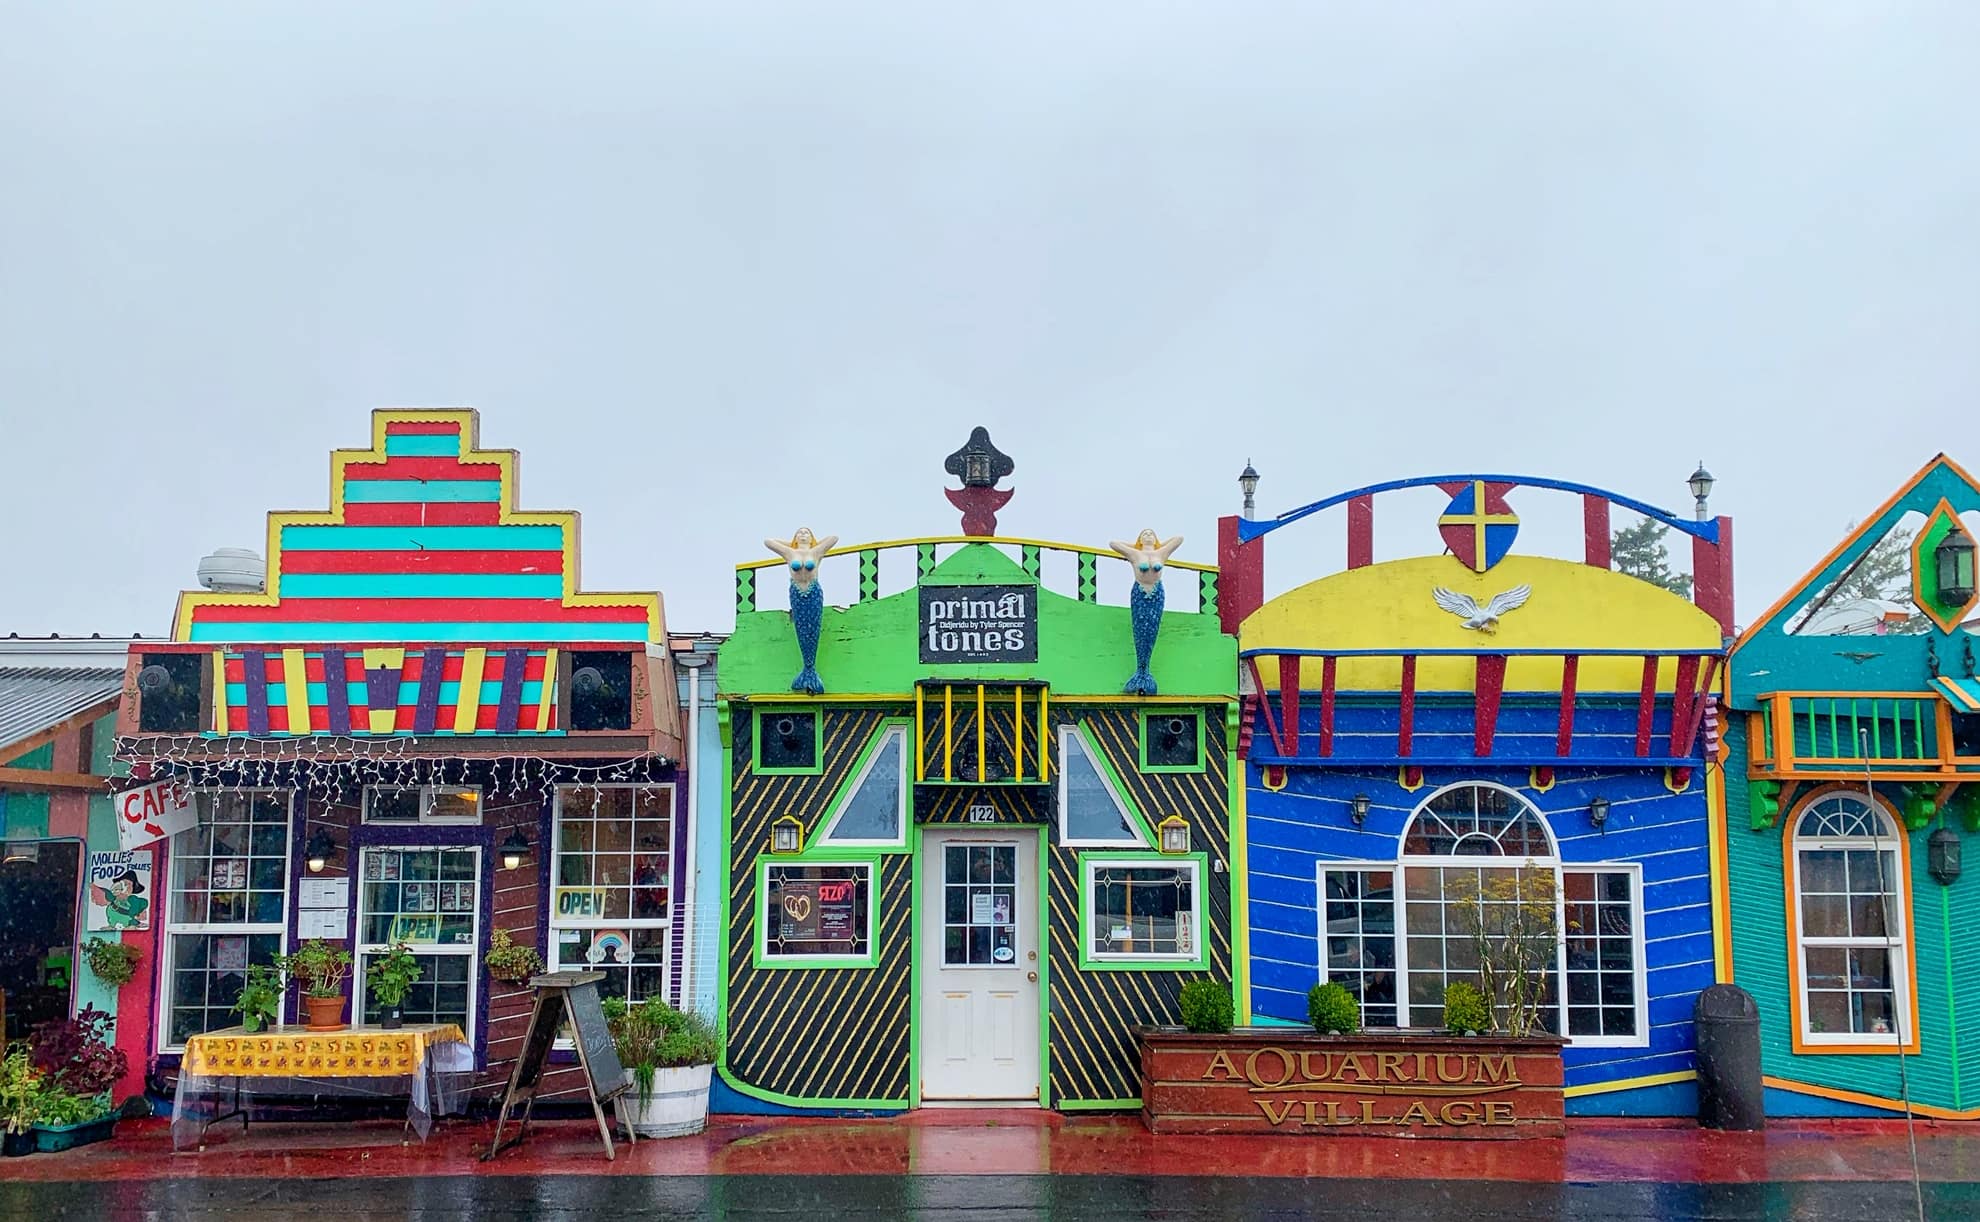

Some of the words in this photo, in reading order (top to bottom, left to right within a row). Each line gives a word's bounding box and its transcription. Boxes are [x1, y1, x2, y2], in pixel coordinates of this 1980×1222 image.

[929, 592, 1026, 625] primal
[970, 621, 979, 629] by
[980, 621, 998, 629] Tyler
[998, 621, 1025, 629] Spencer
[928, 625, 1025, 652] tones
[124, 778, 188, 824] CAFE
[971, 807, 993, 821] 122
[91, 865, 125, 882] FOOD
[127, 863, 152, 873] FOLLIES
[559, 891, 604, 915] OPEN
[1202, 1047, 1522, 1093] AQUARIUM
[1253, 1100, 1518, 1126] VILLAGE
